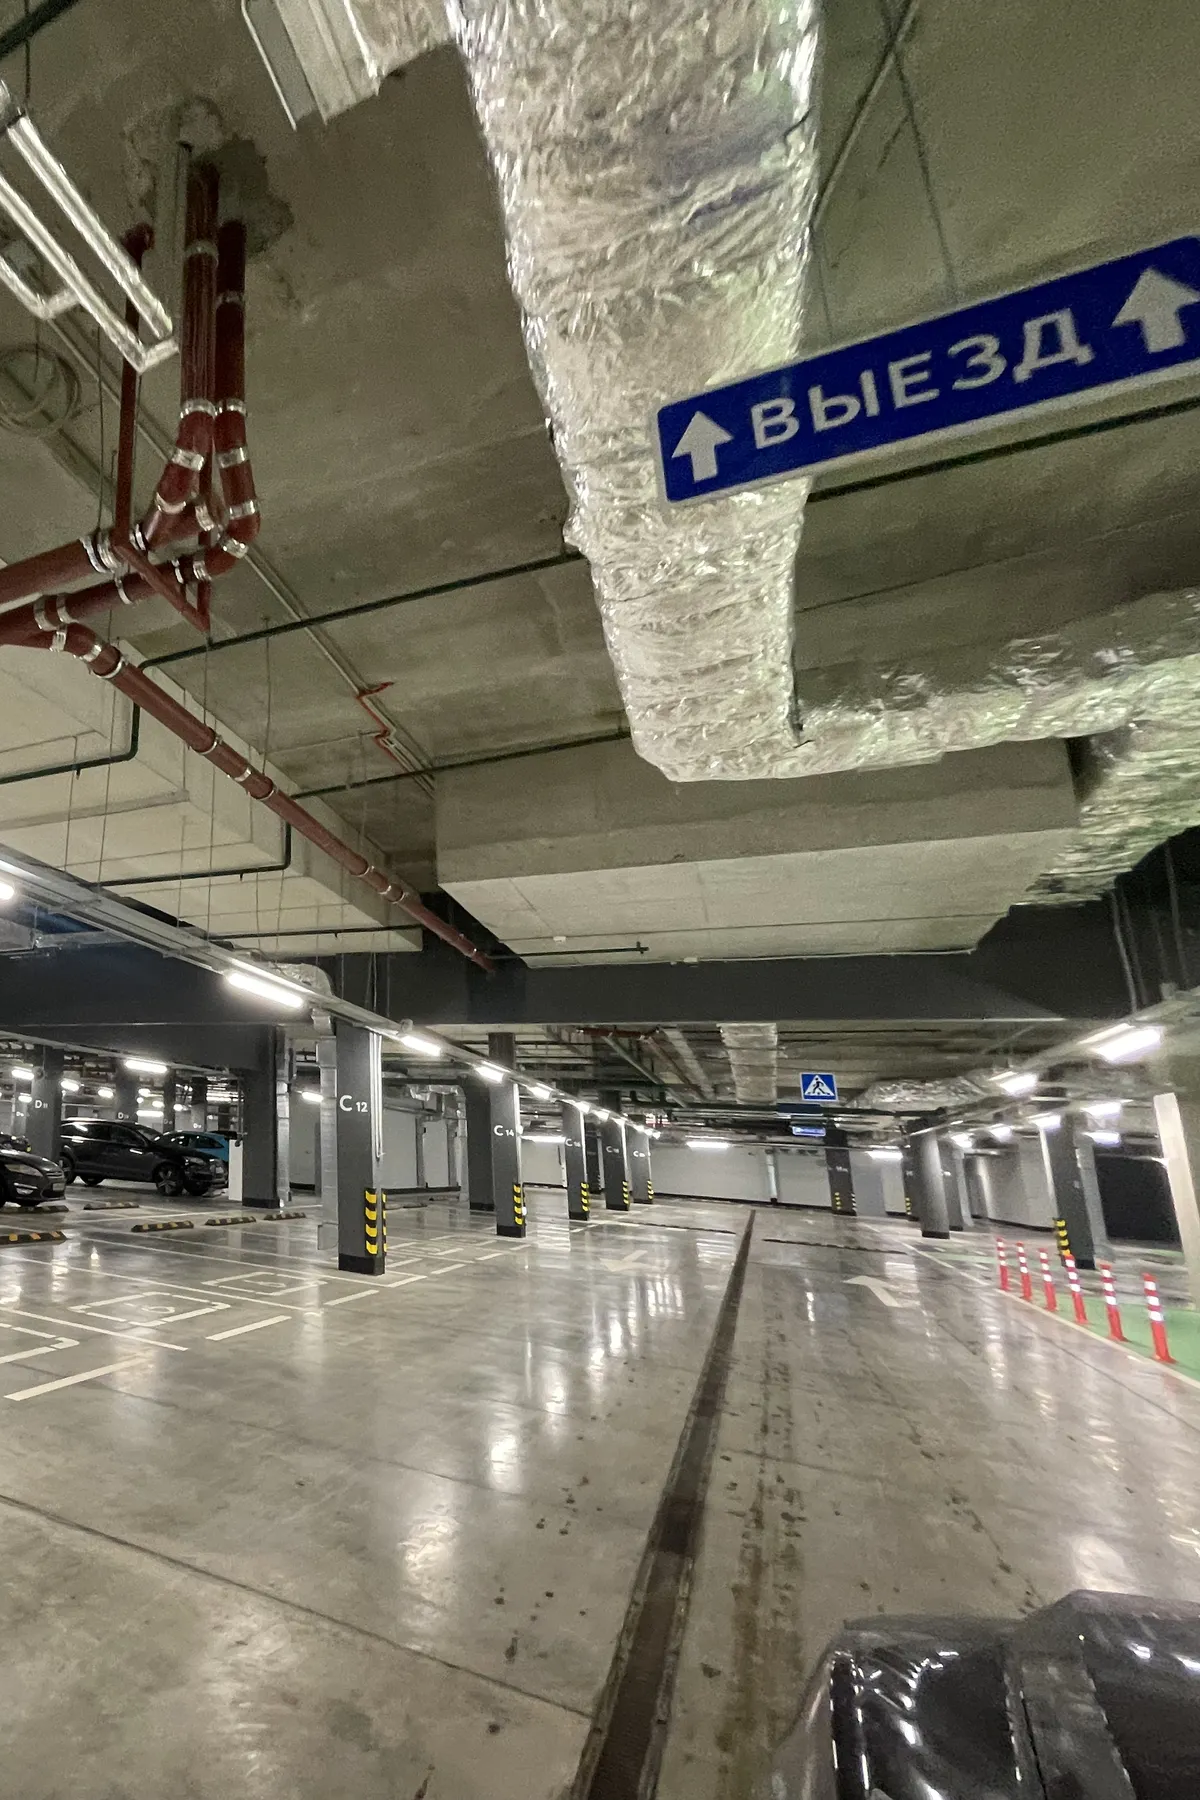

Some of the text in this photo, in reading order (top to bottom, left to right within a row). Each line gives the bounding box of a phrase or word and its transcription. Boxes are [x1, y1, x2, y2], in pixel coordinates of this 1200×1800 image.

[751, 307, 1095, 450] ВЫЕЗД
[339, 1095, 368, 1113] C 12
